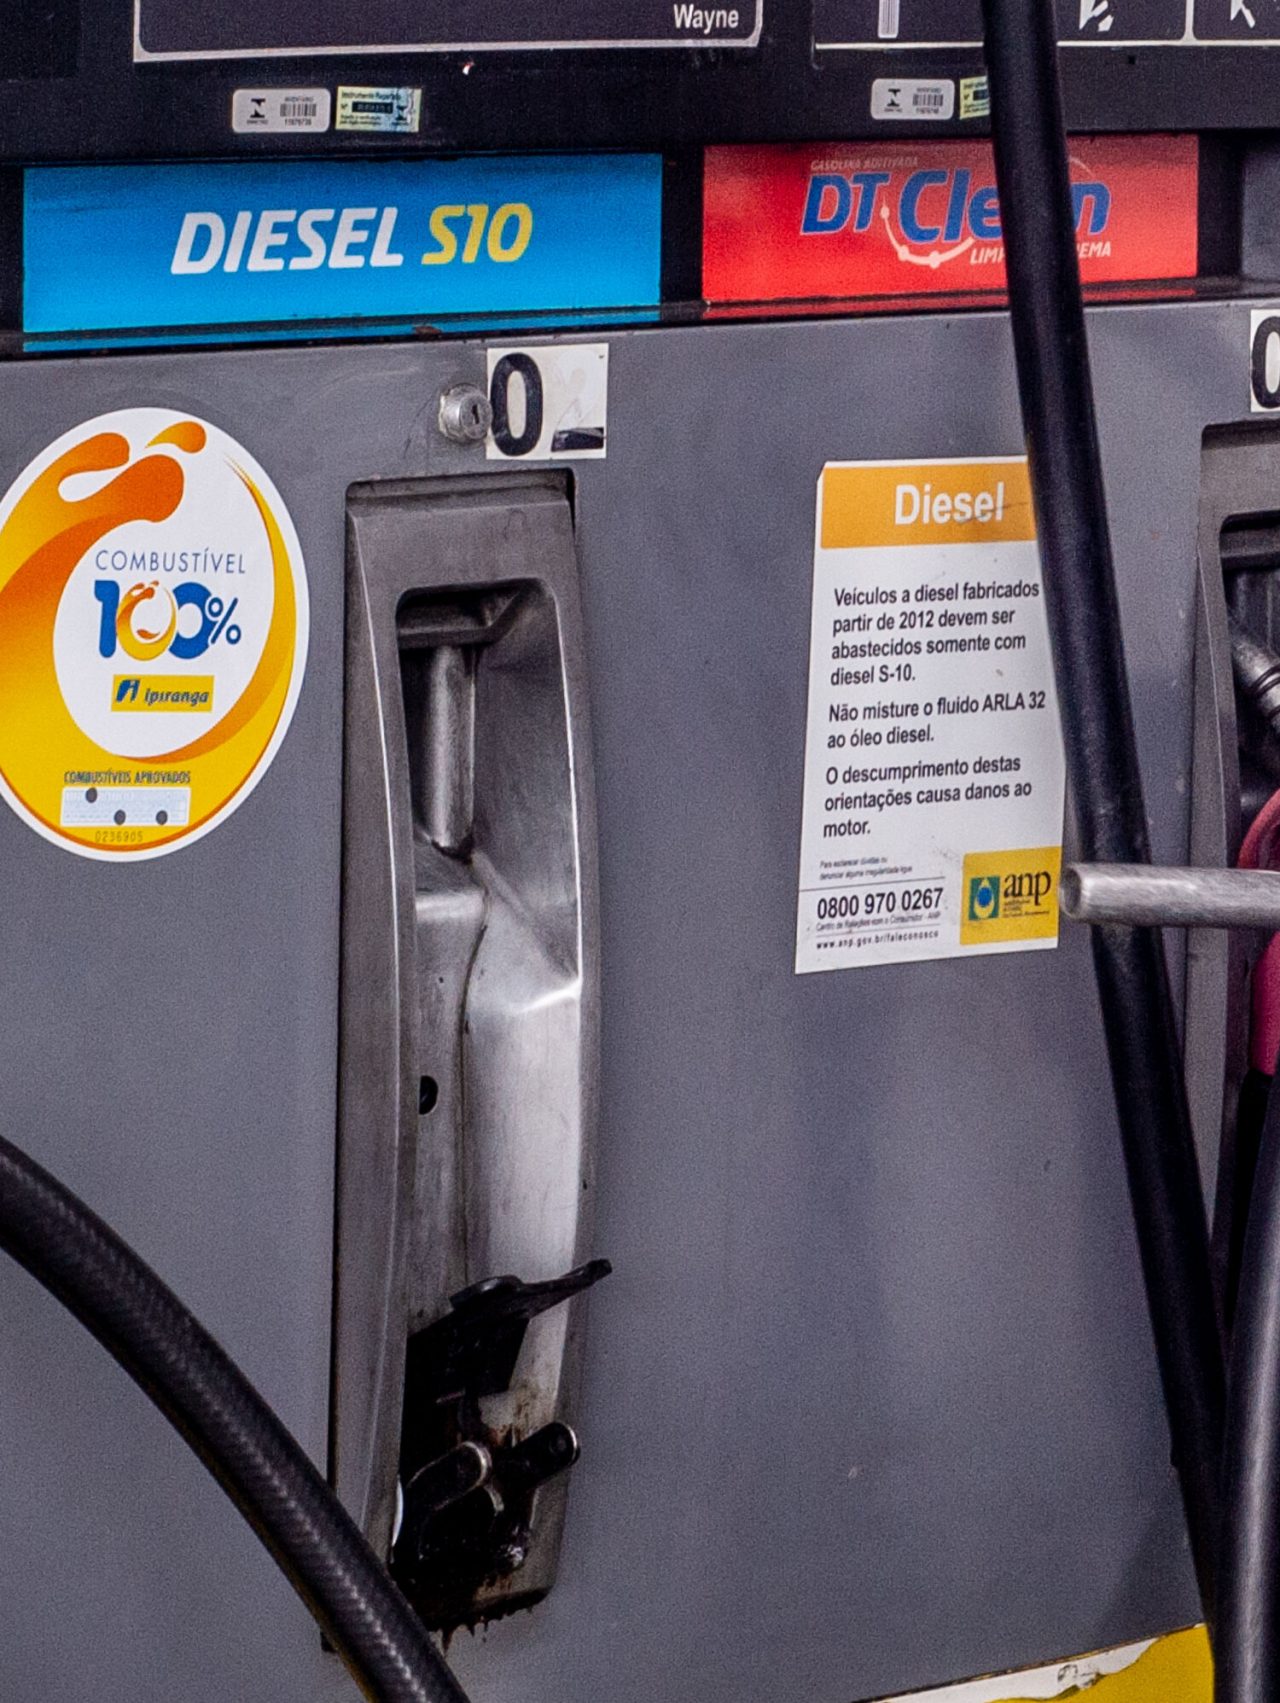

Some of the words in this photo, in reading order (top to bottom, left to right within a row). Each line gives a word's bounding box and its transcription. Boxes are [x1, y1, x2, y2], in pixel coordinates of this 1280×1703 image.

[674, 3, 739, 34] Wayne
[799, 170, 891, 236] DT
[899, 167, 1111, 244] Clen
[170, 206, 404, 276] DIESEL
[421, 202, 533, 266] S10
[894, 481, 1005, 525] Diesel
[95, 547, 246, 574] COMBUSTÍVEL
[834, 586, 897, 607] Veículos
[901, 591, 910, 603] a
[914, 583, 959, 602] diesel
[963, 579, 1040, 600] fabricados
[94, 580, 242, 661] 100%
[832, 614, 872, 638] partir
[876, 612, 895, 630] de
[899, 609, 934, 629] 2012
[938, 609, 987, 628] devem
[991, 609, 1015, 625] ser
[831, 639, 922, 660] abastecidos
[926, 634, 990, 655] somente
[994, 634, 1026, 651] com
[830, 666, 874, 686] diesel
[878, 663, 916, 684] S-10.
[828, 703, 859, 723] Não
[862, 700, 919, 720] misture
[923, 701, 933, 716] o
[937, 696, 979, 715] fluido
[982, 692, 1026, 712] ARLA
[1028, 691, 1046, 709] 32
[827, 733, 846, 749] ao
[849, 728, 882, 747] óleo
[886, 723, 935, 744] diesel.
[825, 766, 838, 785] O
[842, 761, 969, 784] descumprimento
[973, 756, 1021, 775] destas
[824, 788, 912, 813] orientações
[916, 786, 961, 804] causa
[965, 782, 1010, 800] danos
[1014, 782, 1032, 797] ao
[823, 819, 871, 839] motor.
[817, 895, 859, 919] 0800
[864, 891, 896, 914] 970
[901, 887, 944, 911] 0267
[1003, 870, 1052, 906] anp
